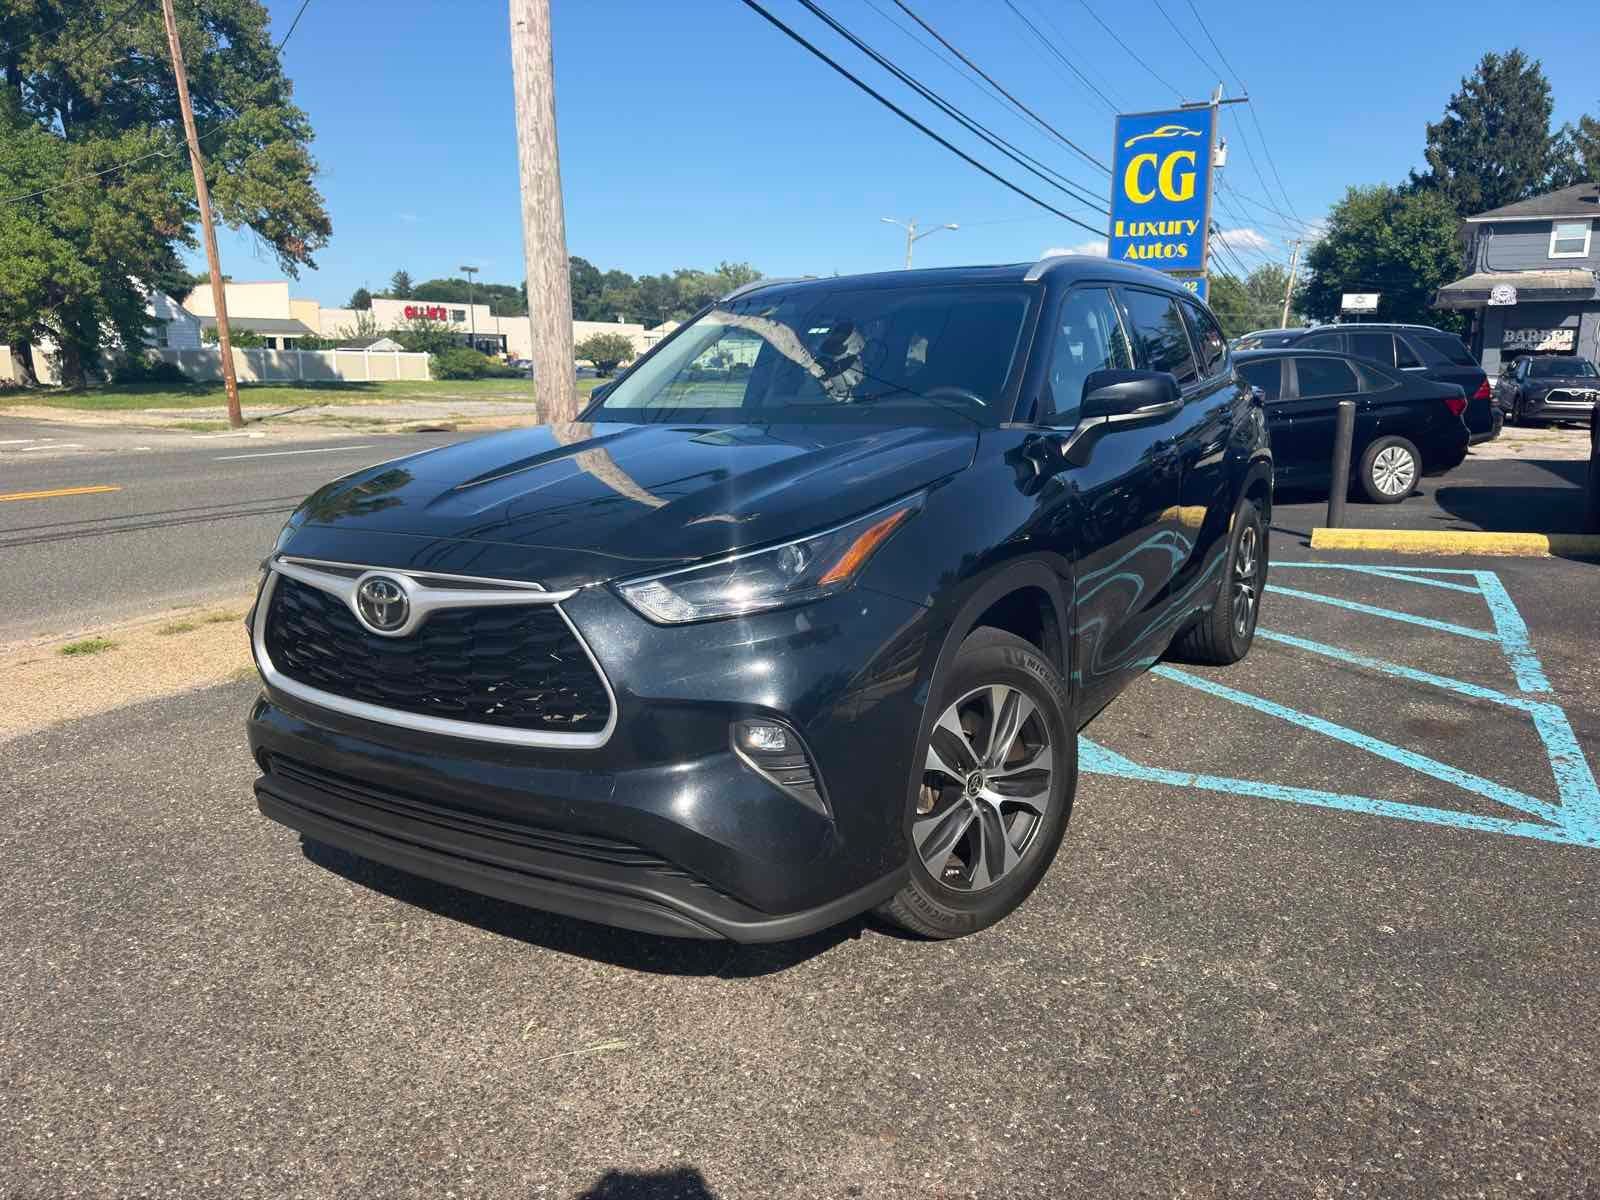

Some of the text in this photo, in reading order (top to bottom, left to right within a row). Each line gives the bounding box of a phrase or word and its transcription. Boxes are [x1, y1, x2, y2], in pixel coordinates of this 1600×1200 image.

[1124, 150, 1197, 204] CG
[1115, 219, 1199, 237] Luxury
[1123, 242, 1189, 260] Autos
